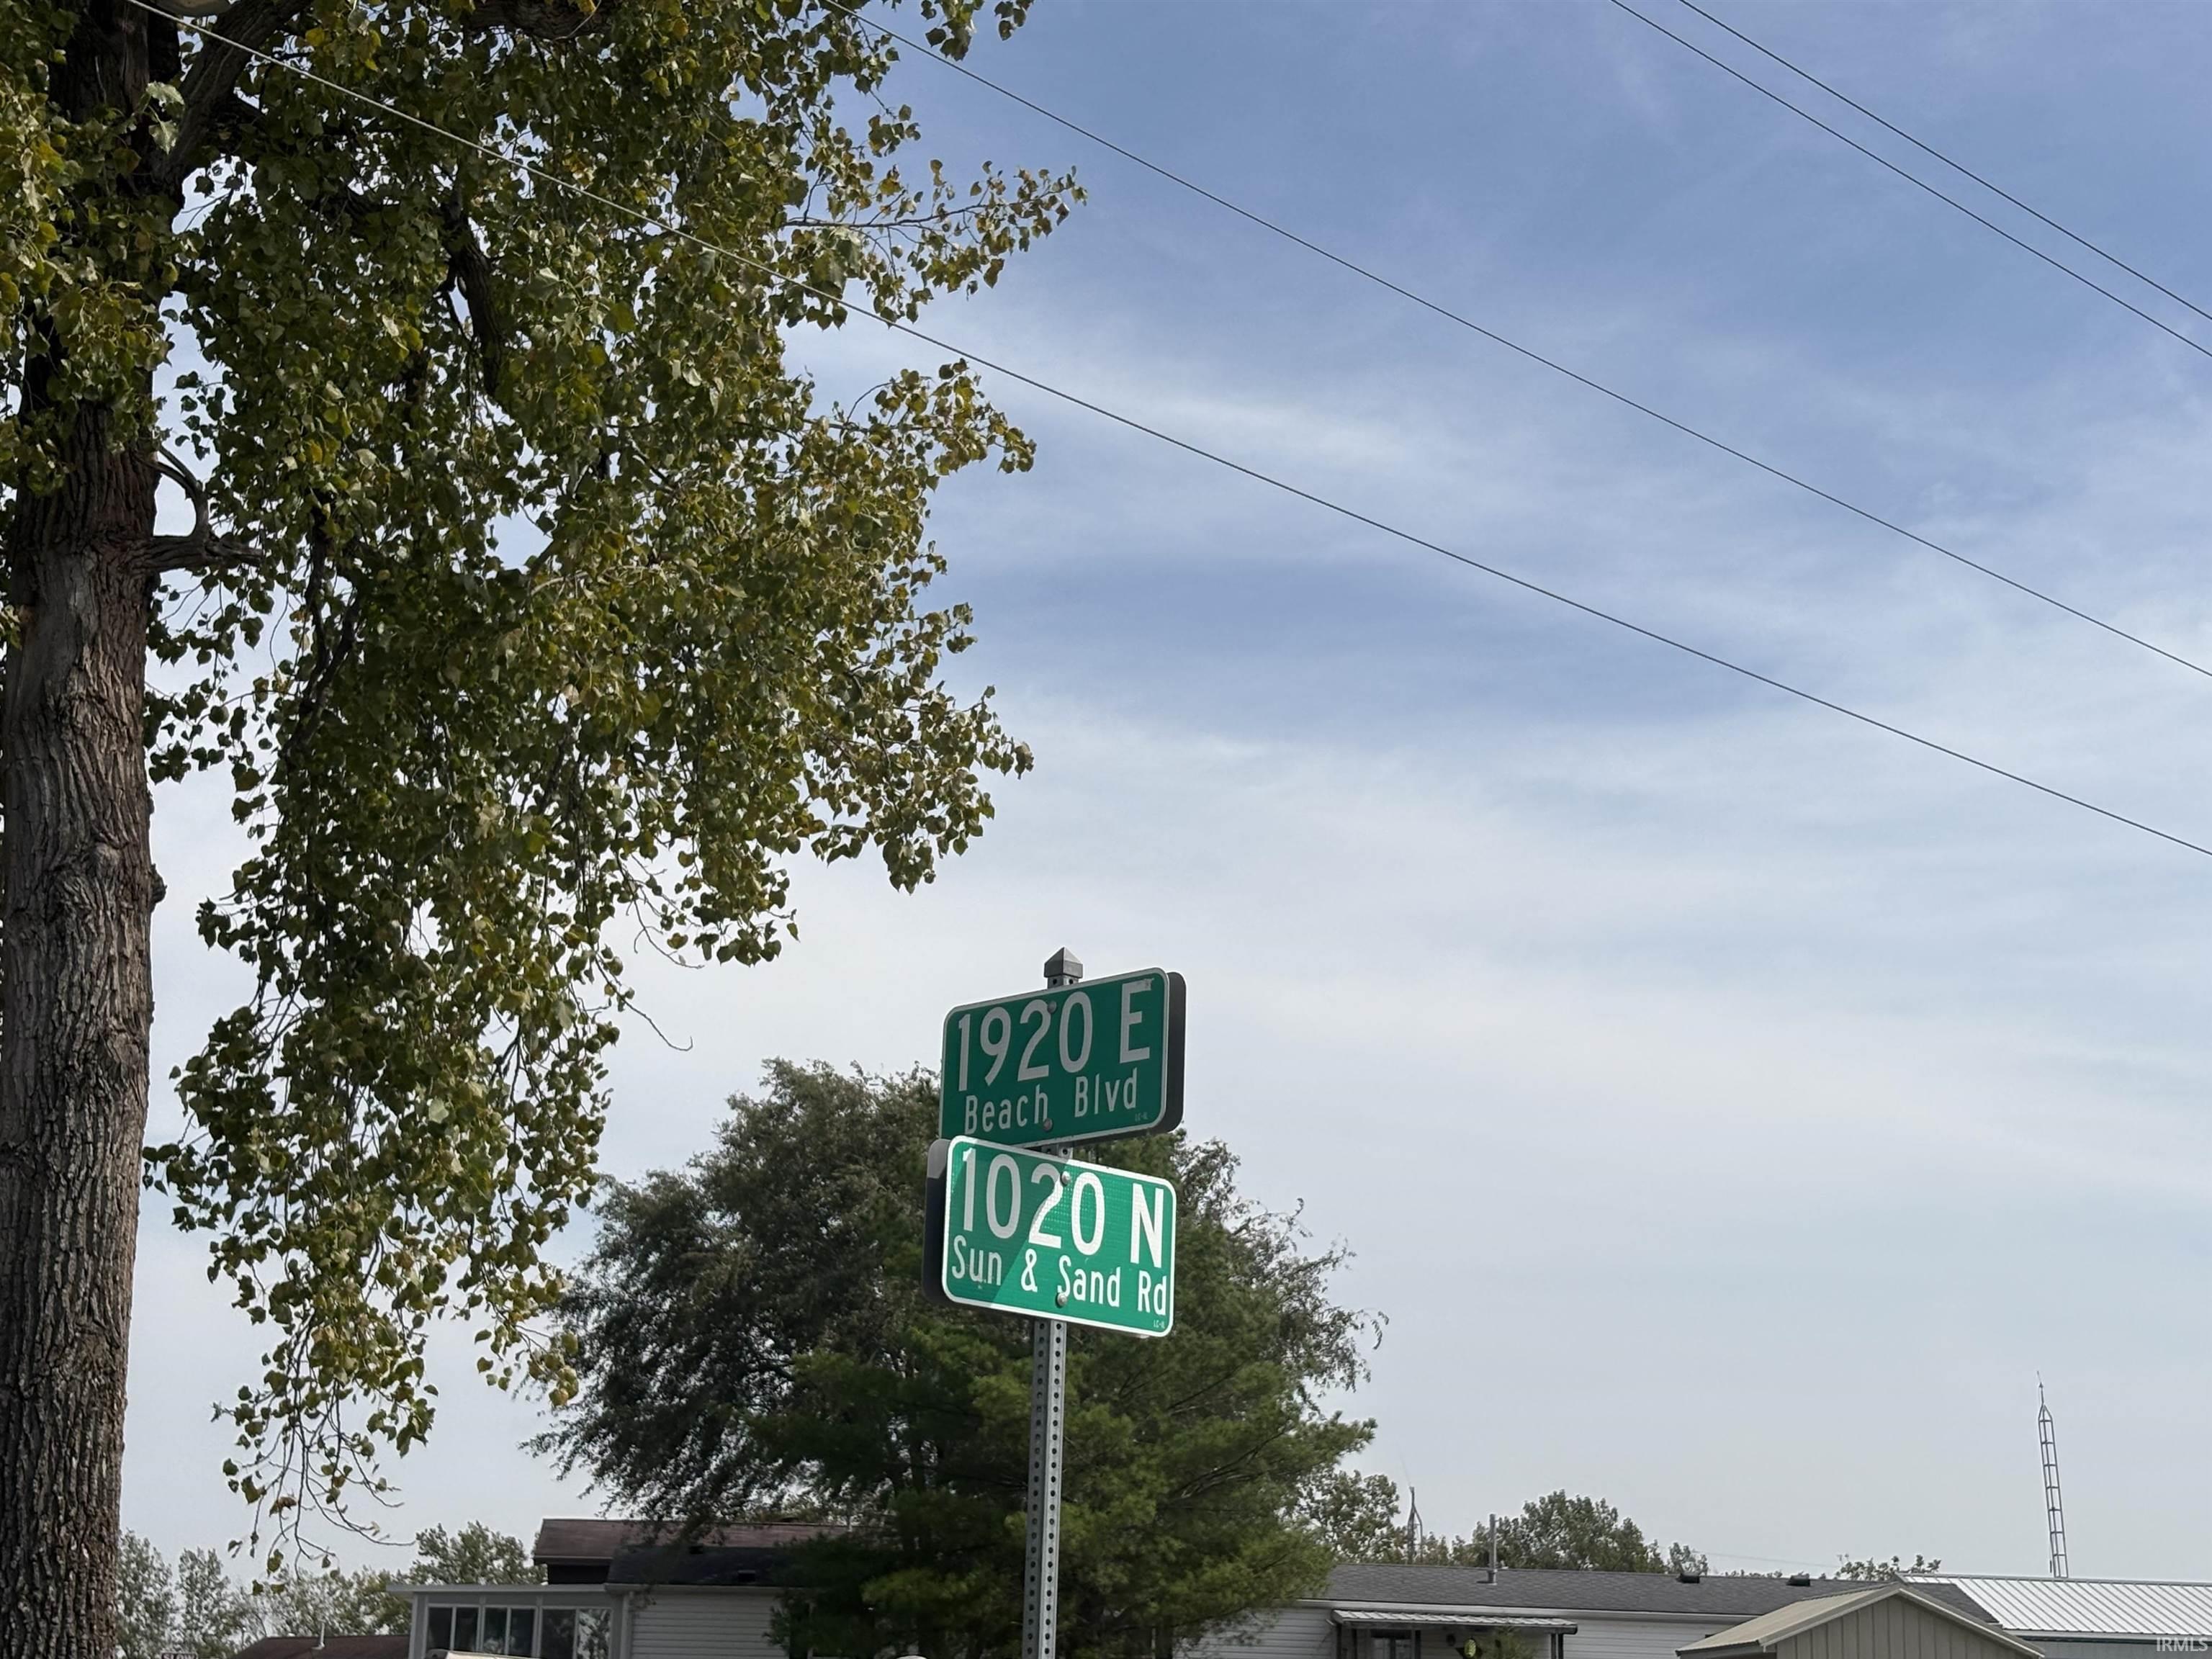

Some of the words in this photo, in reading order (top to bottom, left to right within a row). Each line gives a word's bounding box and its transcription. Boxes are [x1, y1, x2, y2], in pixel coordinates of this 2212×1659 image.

[958, 992, 1093, 1092] 1920
[1119, 978, 1154, 1064] E
[964, 1084, 1048, 1135] Beach
[1074, 1067, 1138, 1118] Blvd
[963, 1147, 1105, 1256] 1020
[1130, 1182, 1164, 1268] N
[951, 1235, 1002, 1286] Sun
[1021, 1249, 1038, 1292] &
[1058, 1255, 1120, 1308] Sand
[1137, 1269, 1166, 1316] Rd
